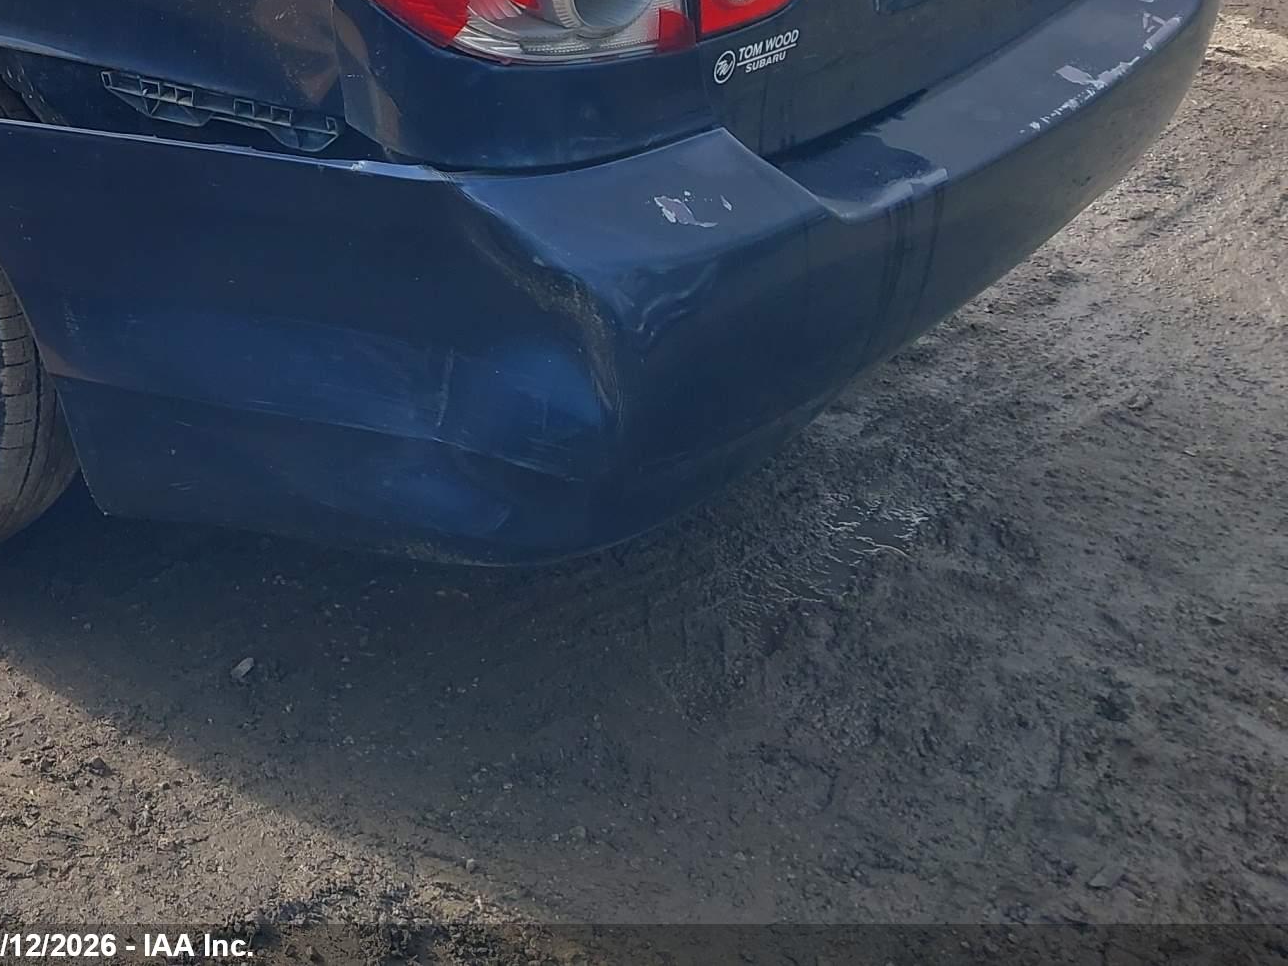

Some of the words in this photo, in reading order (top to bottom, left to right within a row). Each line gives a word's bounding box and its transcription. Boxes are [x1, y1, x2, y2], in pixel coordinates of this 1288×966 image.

[738, 41, 764, 62] TOM
[765, 29, 800, 52] WOOD
[745, 50, 787, 74] SUBARU
